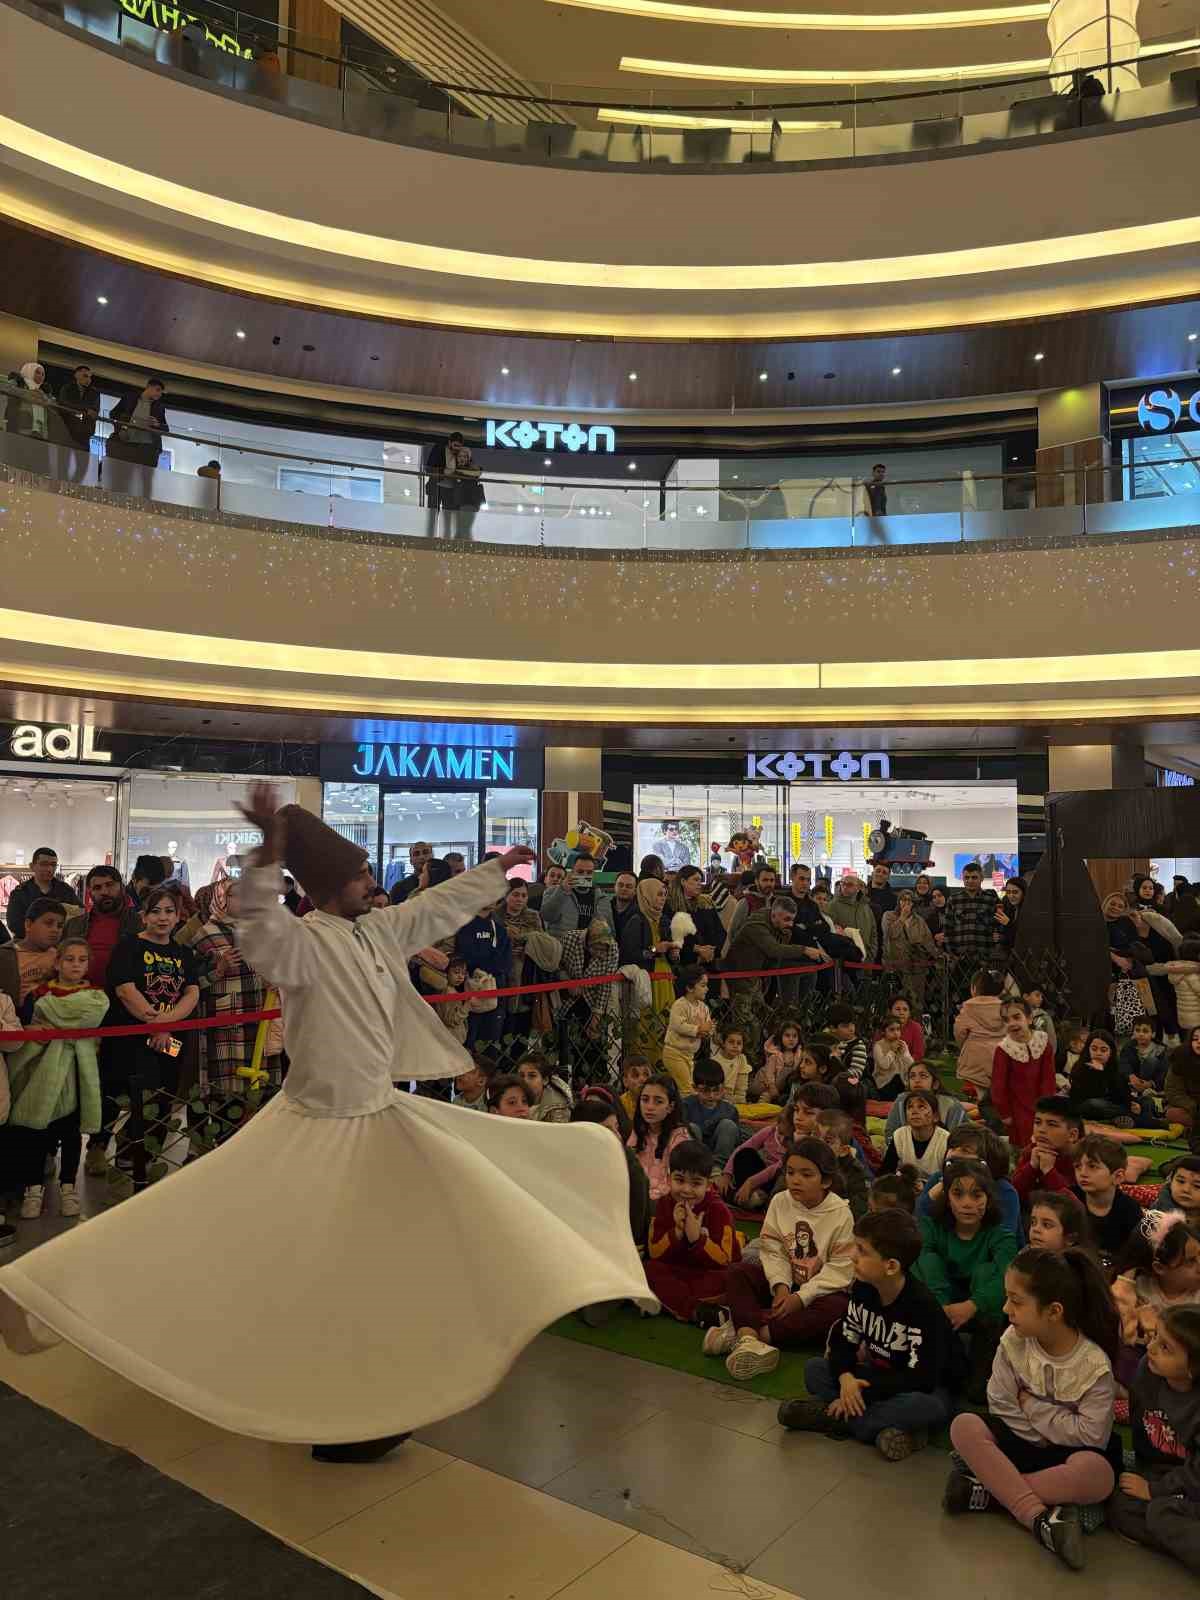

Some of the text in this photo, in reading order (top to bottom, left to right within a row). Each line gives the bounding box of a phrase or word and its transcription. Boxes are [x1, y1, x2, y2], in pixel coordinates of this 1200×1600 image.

[486, 420, 615, 452] KOTON
[353, 744, 514, 781] JAKAMEN
[747, 751, 890, 780] KOTON
